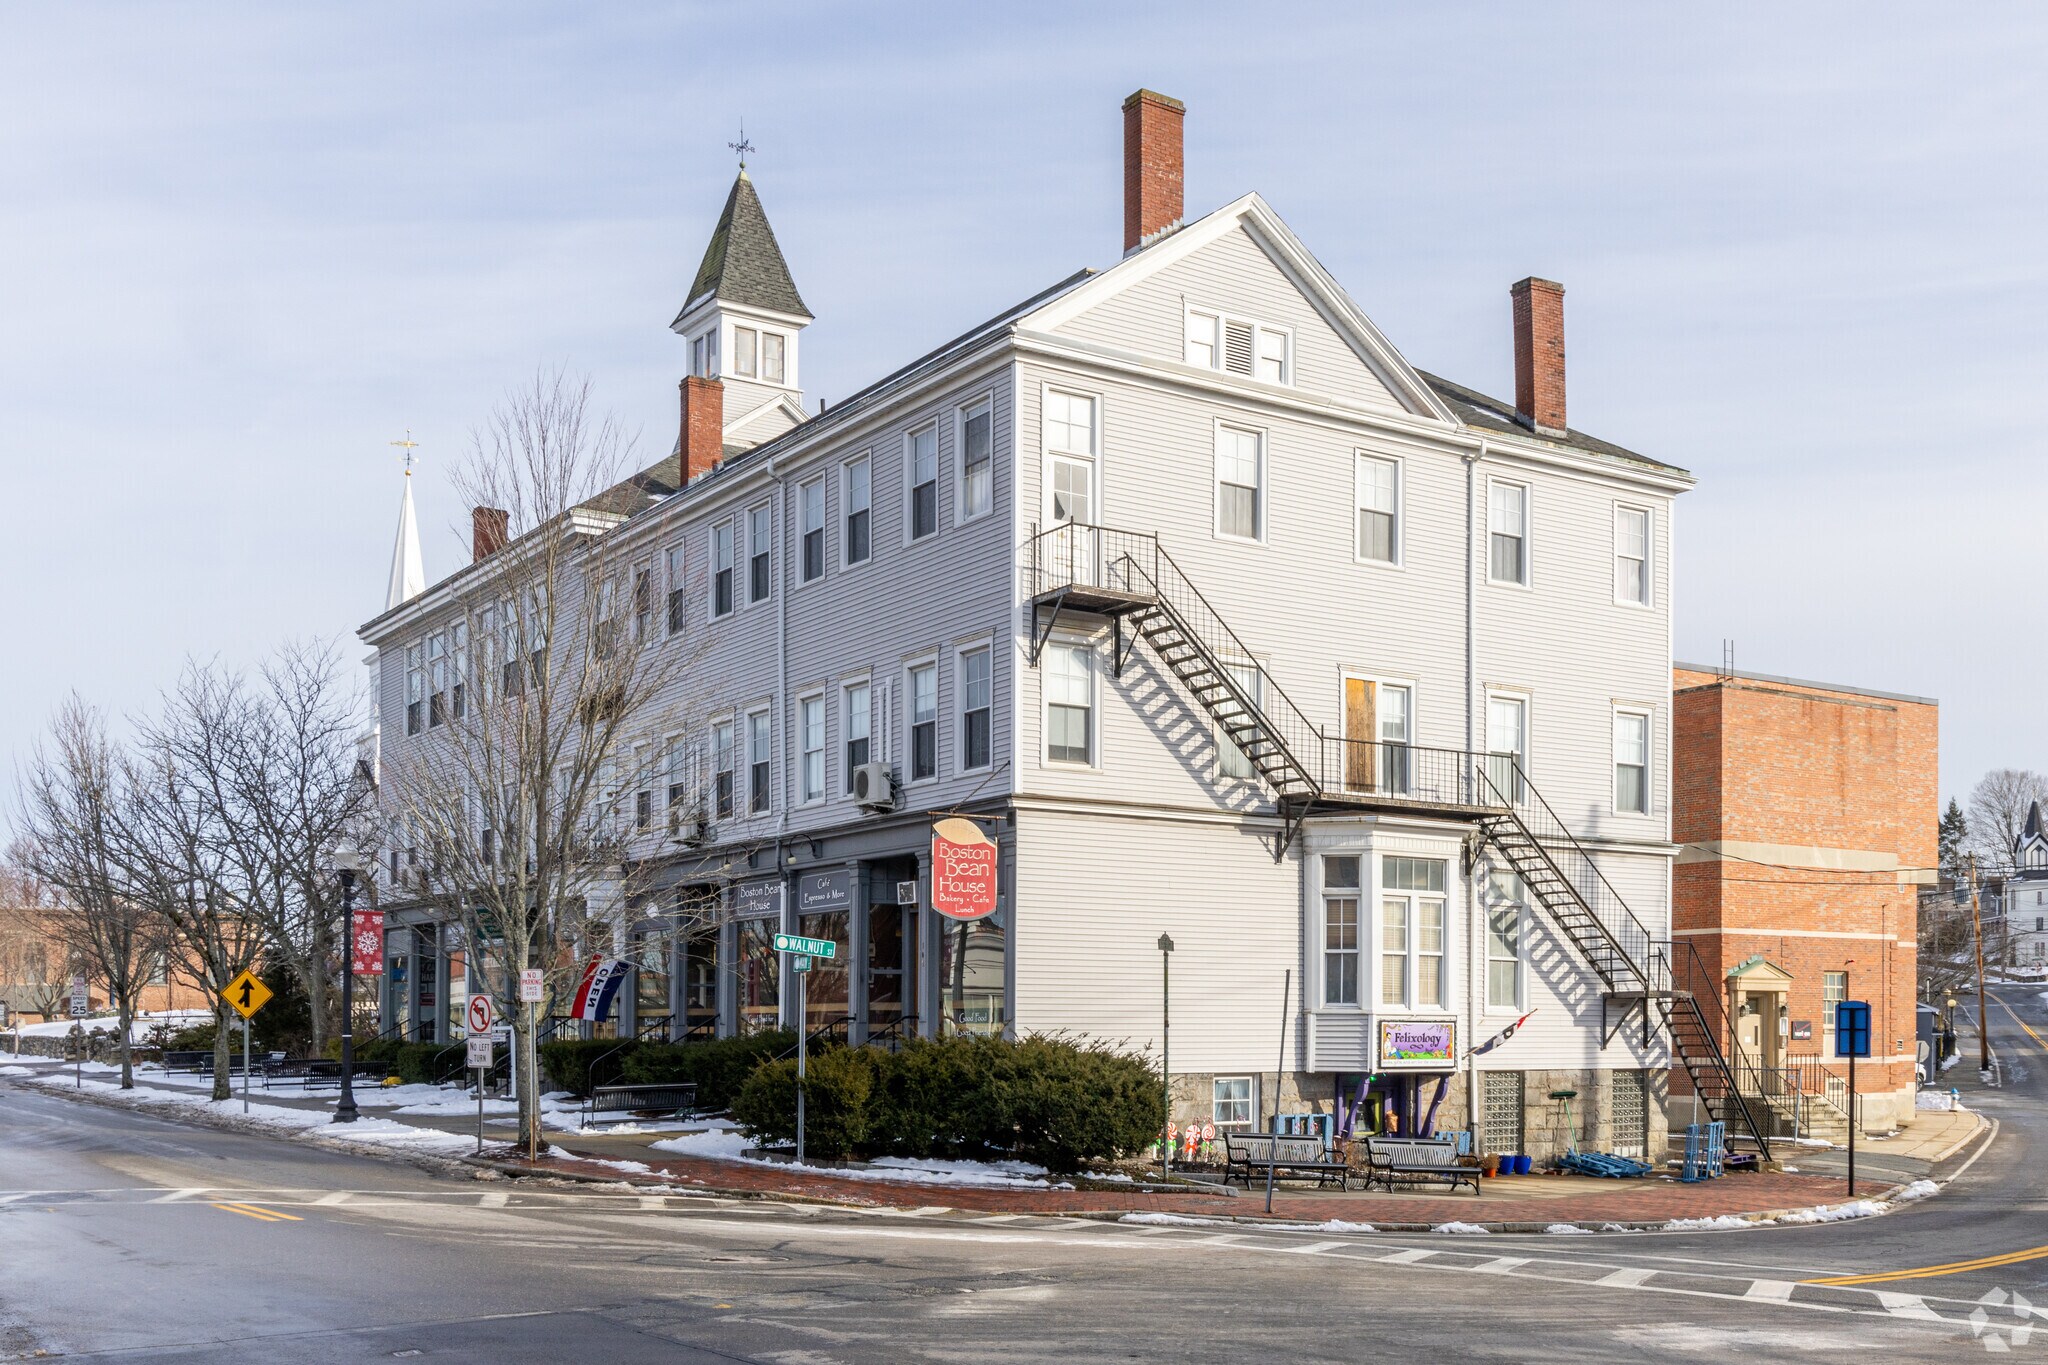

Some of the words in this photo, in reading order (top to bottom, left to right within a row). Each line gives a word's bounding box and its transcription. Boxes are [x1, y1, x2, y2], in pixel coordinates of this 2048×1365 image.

[939, 842, 991, 860] Boston
[945, 858, 989, 877] Bean
[939, 876, 986, 893] House
[740, 886, 763, 898] Boston
[804, 892, 826, 905] Espresso
[831, 889, 845, 899] More
[939, 892, 964, 904] Bakery
[972, 893, 990, 903] Cafe
[749, 899, 771, 911] House
[955, 904, 975, 913] Lunch
[789, 938, 825, 955] WALNUT
[527, 971, 537, 979] NO
[72, 1006, 87, 1015] 25
[1394, 1032, 1442, 1048] Felixology
[469, 1042, 477, 1051] NO
[479, 1043, 490, 1052] LEFT
[473, 1054, 487, 1063] TURN
